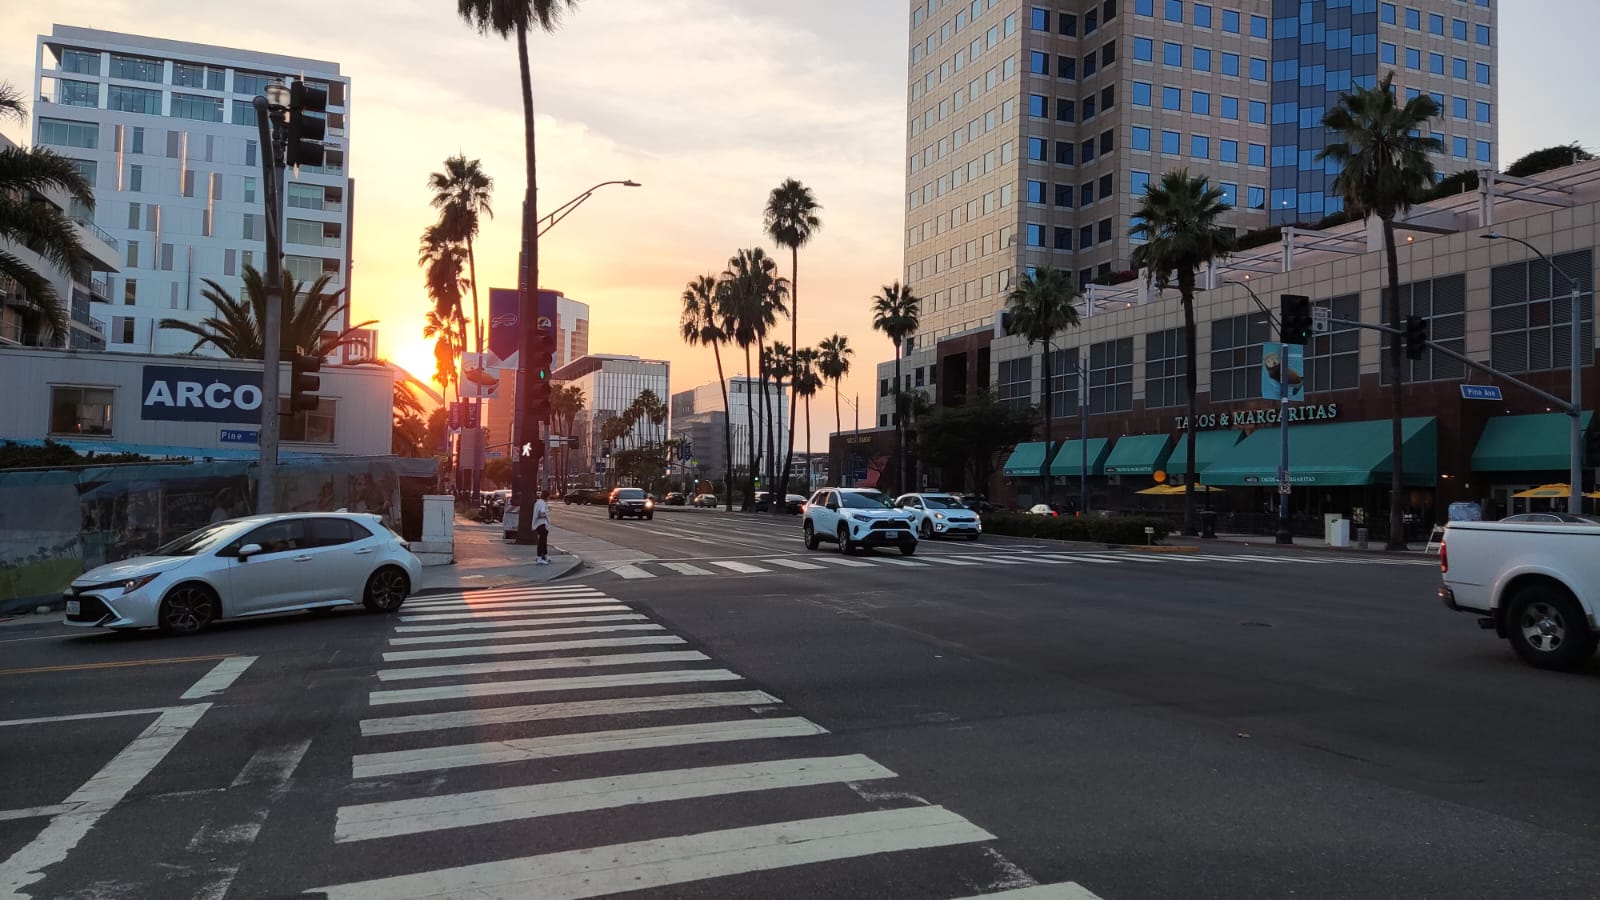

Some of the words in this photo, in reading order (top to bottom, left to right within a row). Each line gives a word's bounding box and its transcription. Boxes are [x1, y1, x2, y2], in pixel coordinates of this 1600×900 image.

[143, 379, 263, 411] ARCO
[1467, 388, 1483, 396] Pine
[1220, 412, 1230, 427] &
[221, 431, 243, 441] Pine
